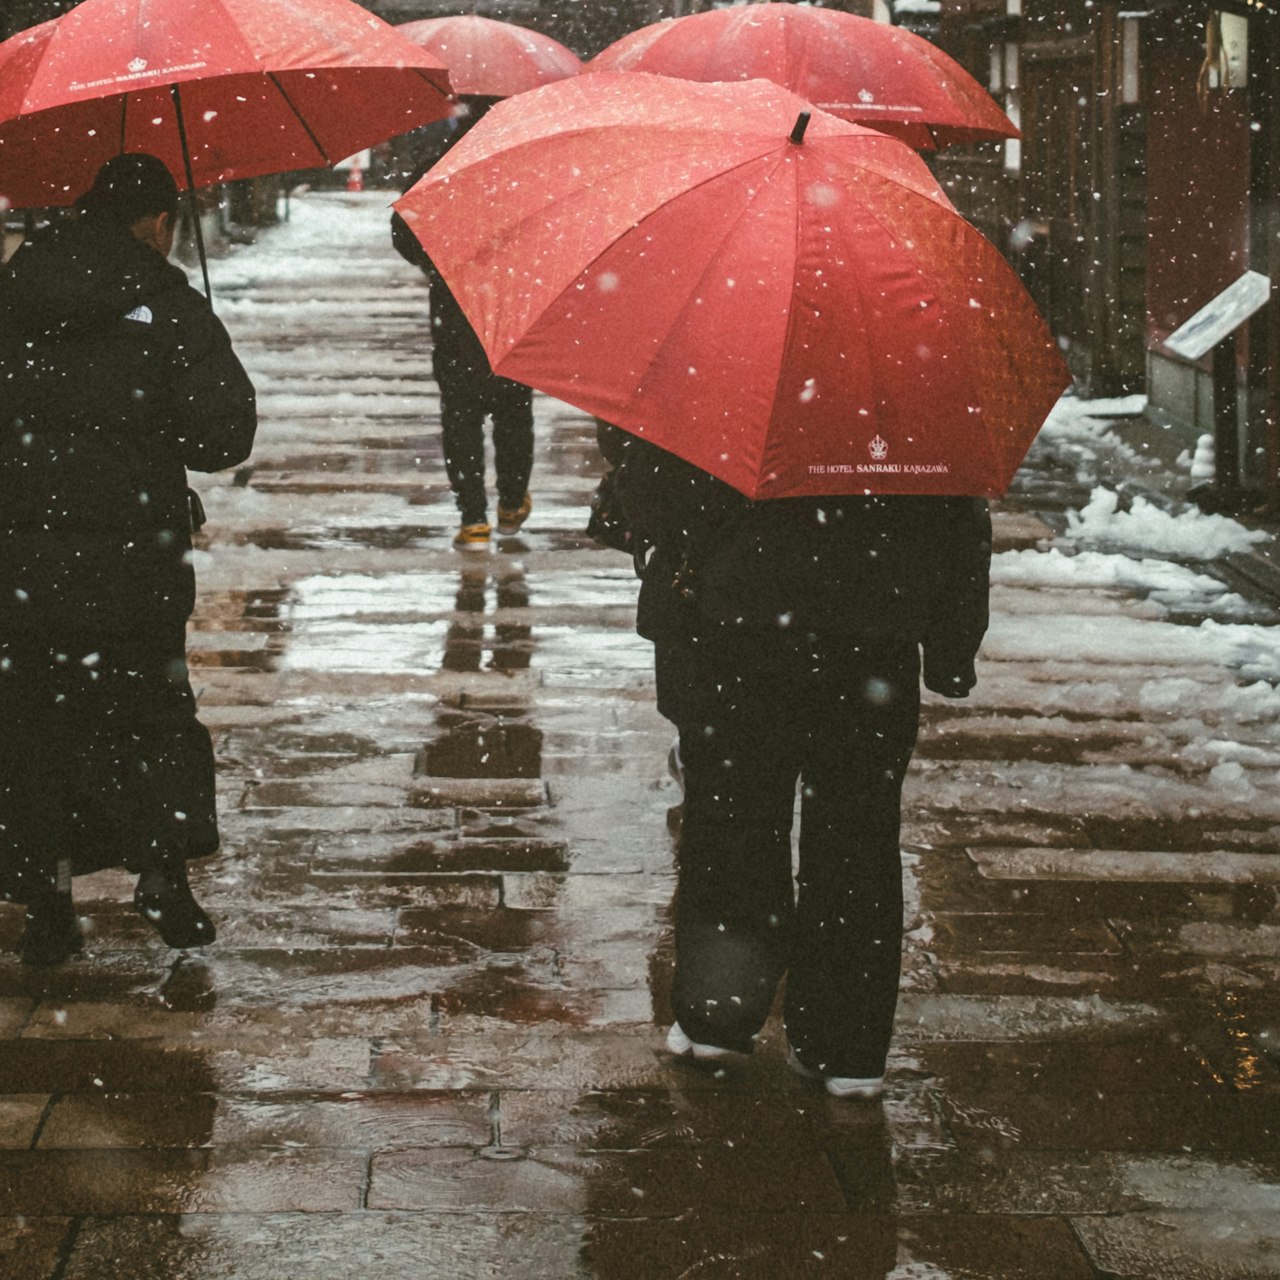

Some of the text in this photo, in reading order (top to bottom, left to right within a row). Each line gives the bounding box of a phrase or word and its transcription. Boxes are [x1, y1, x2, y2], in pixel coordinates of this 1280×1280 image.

[116, 70, 160, 82] SANRAKU
[808, 464, 948, 474] THE HOTEL SANRAKU KANAZAWA
